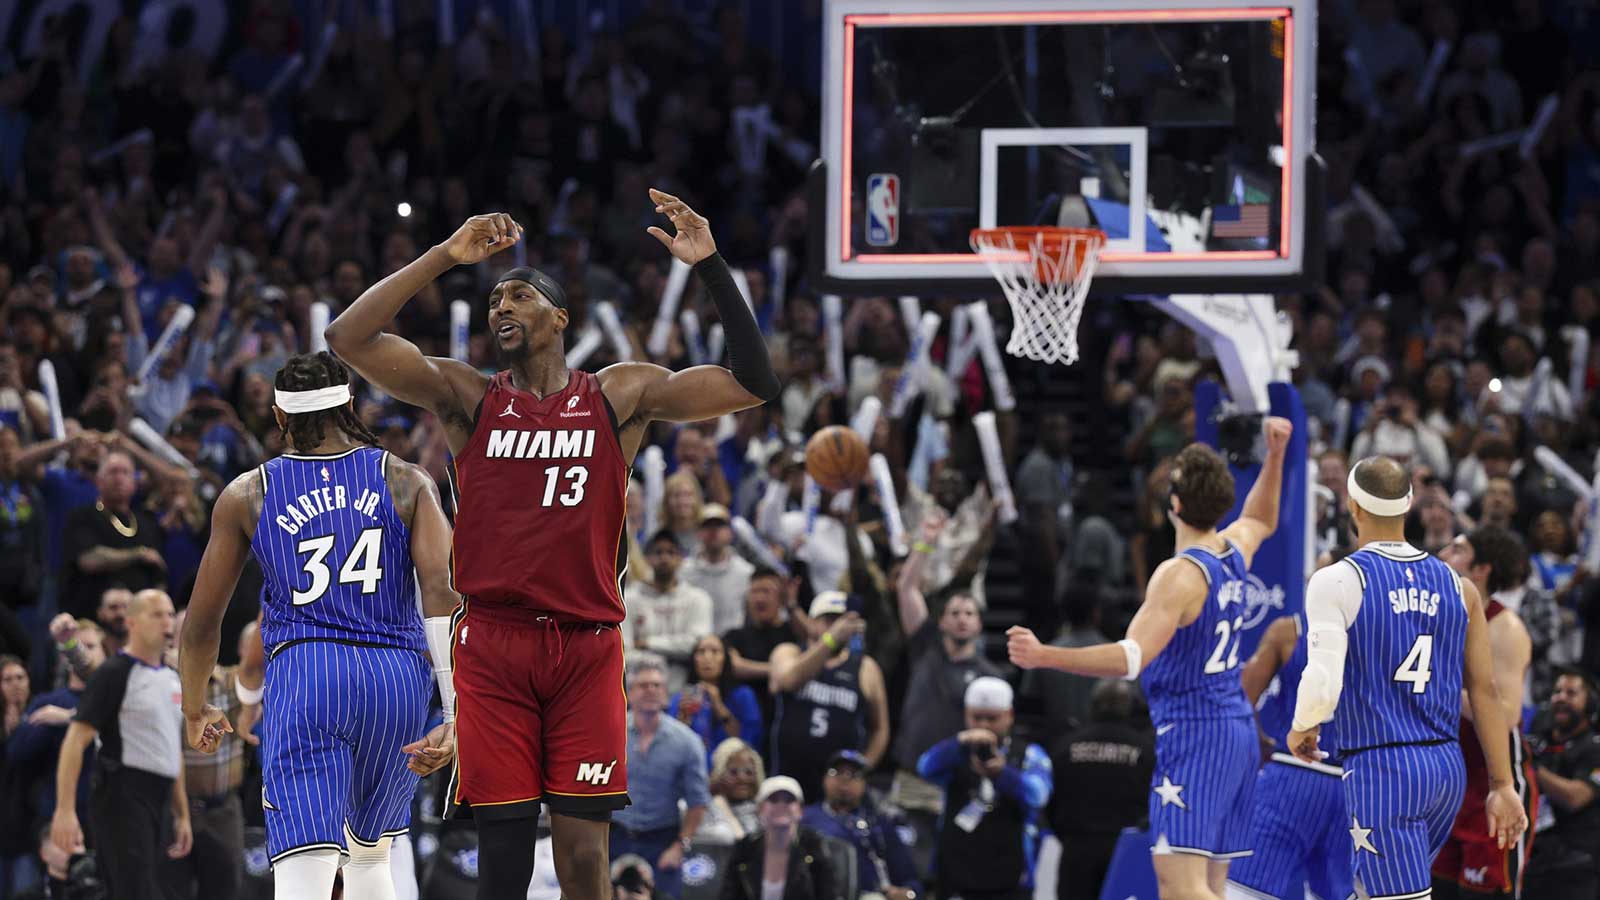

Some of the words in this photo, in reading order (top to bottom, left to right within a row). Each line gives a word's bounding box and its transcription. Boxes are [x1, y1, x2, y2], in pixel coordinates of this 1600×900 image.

[486, 429, 596, 459] MIAMI
[541, 465, 589, 507] 13
[275, 485, 346, 535] CARTER
[353, 488, 381, 521] JR.
[291, 527, 383, 606] 34
[1388, 587, 1441, 617] SUGGS
[1393, 634, 1433, 694] 4
[809, 708, 829, 737] 5
[1071, 741, 1140, 766] SECURITY
